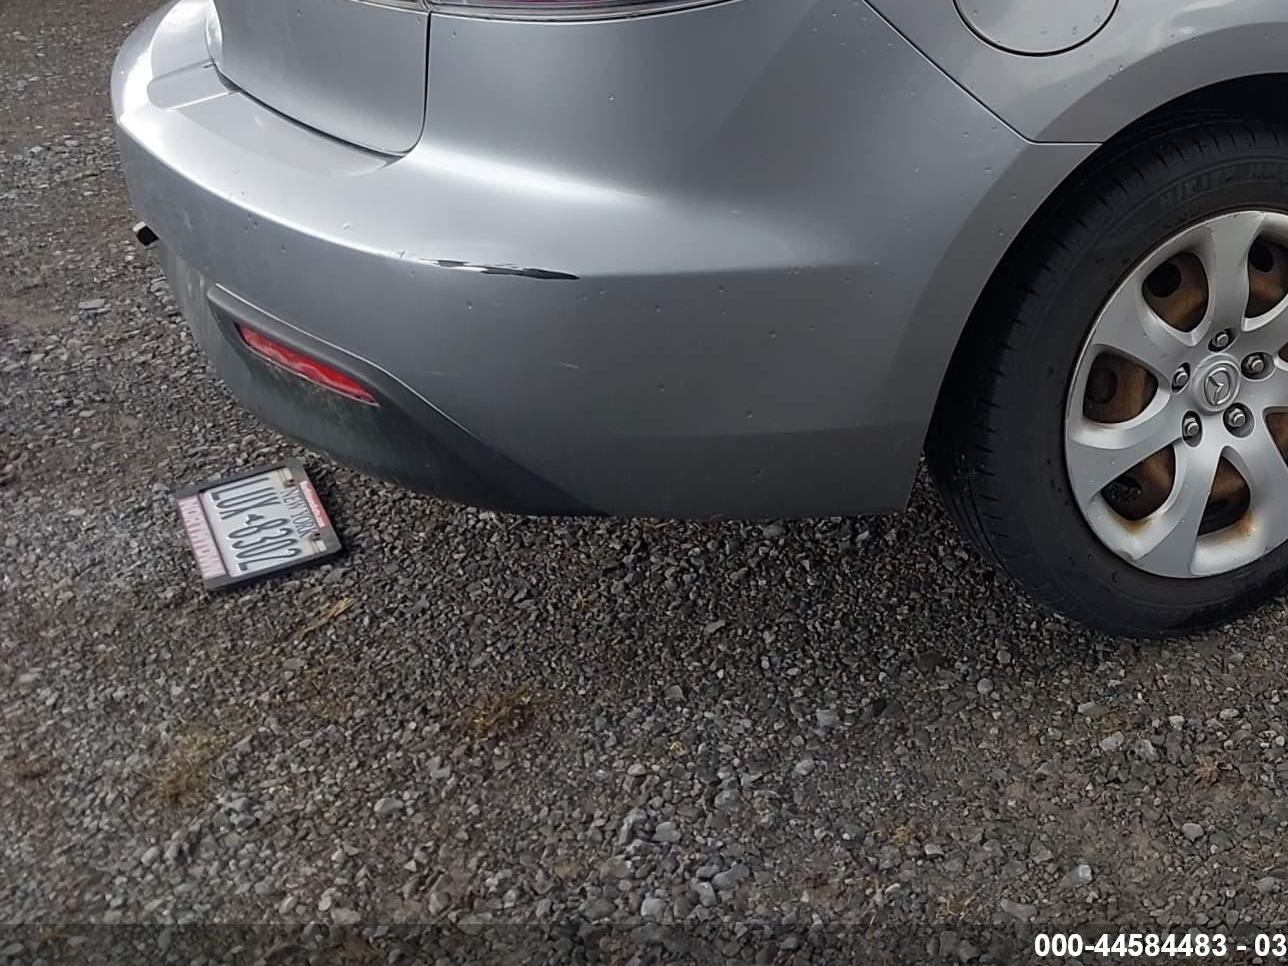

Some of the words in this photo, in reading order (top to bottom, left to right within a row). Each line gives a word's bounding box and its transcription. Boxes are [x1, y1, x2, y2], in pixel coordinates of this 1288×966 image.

[211, 477, 281, 520] LUX
[280, 487, 305, 511] NEW
[289, 509, 317, 538] YORK
[228, 518, 302, 571] 8302
